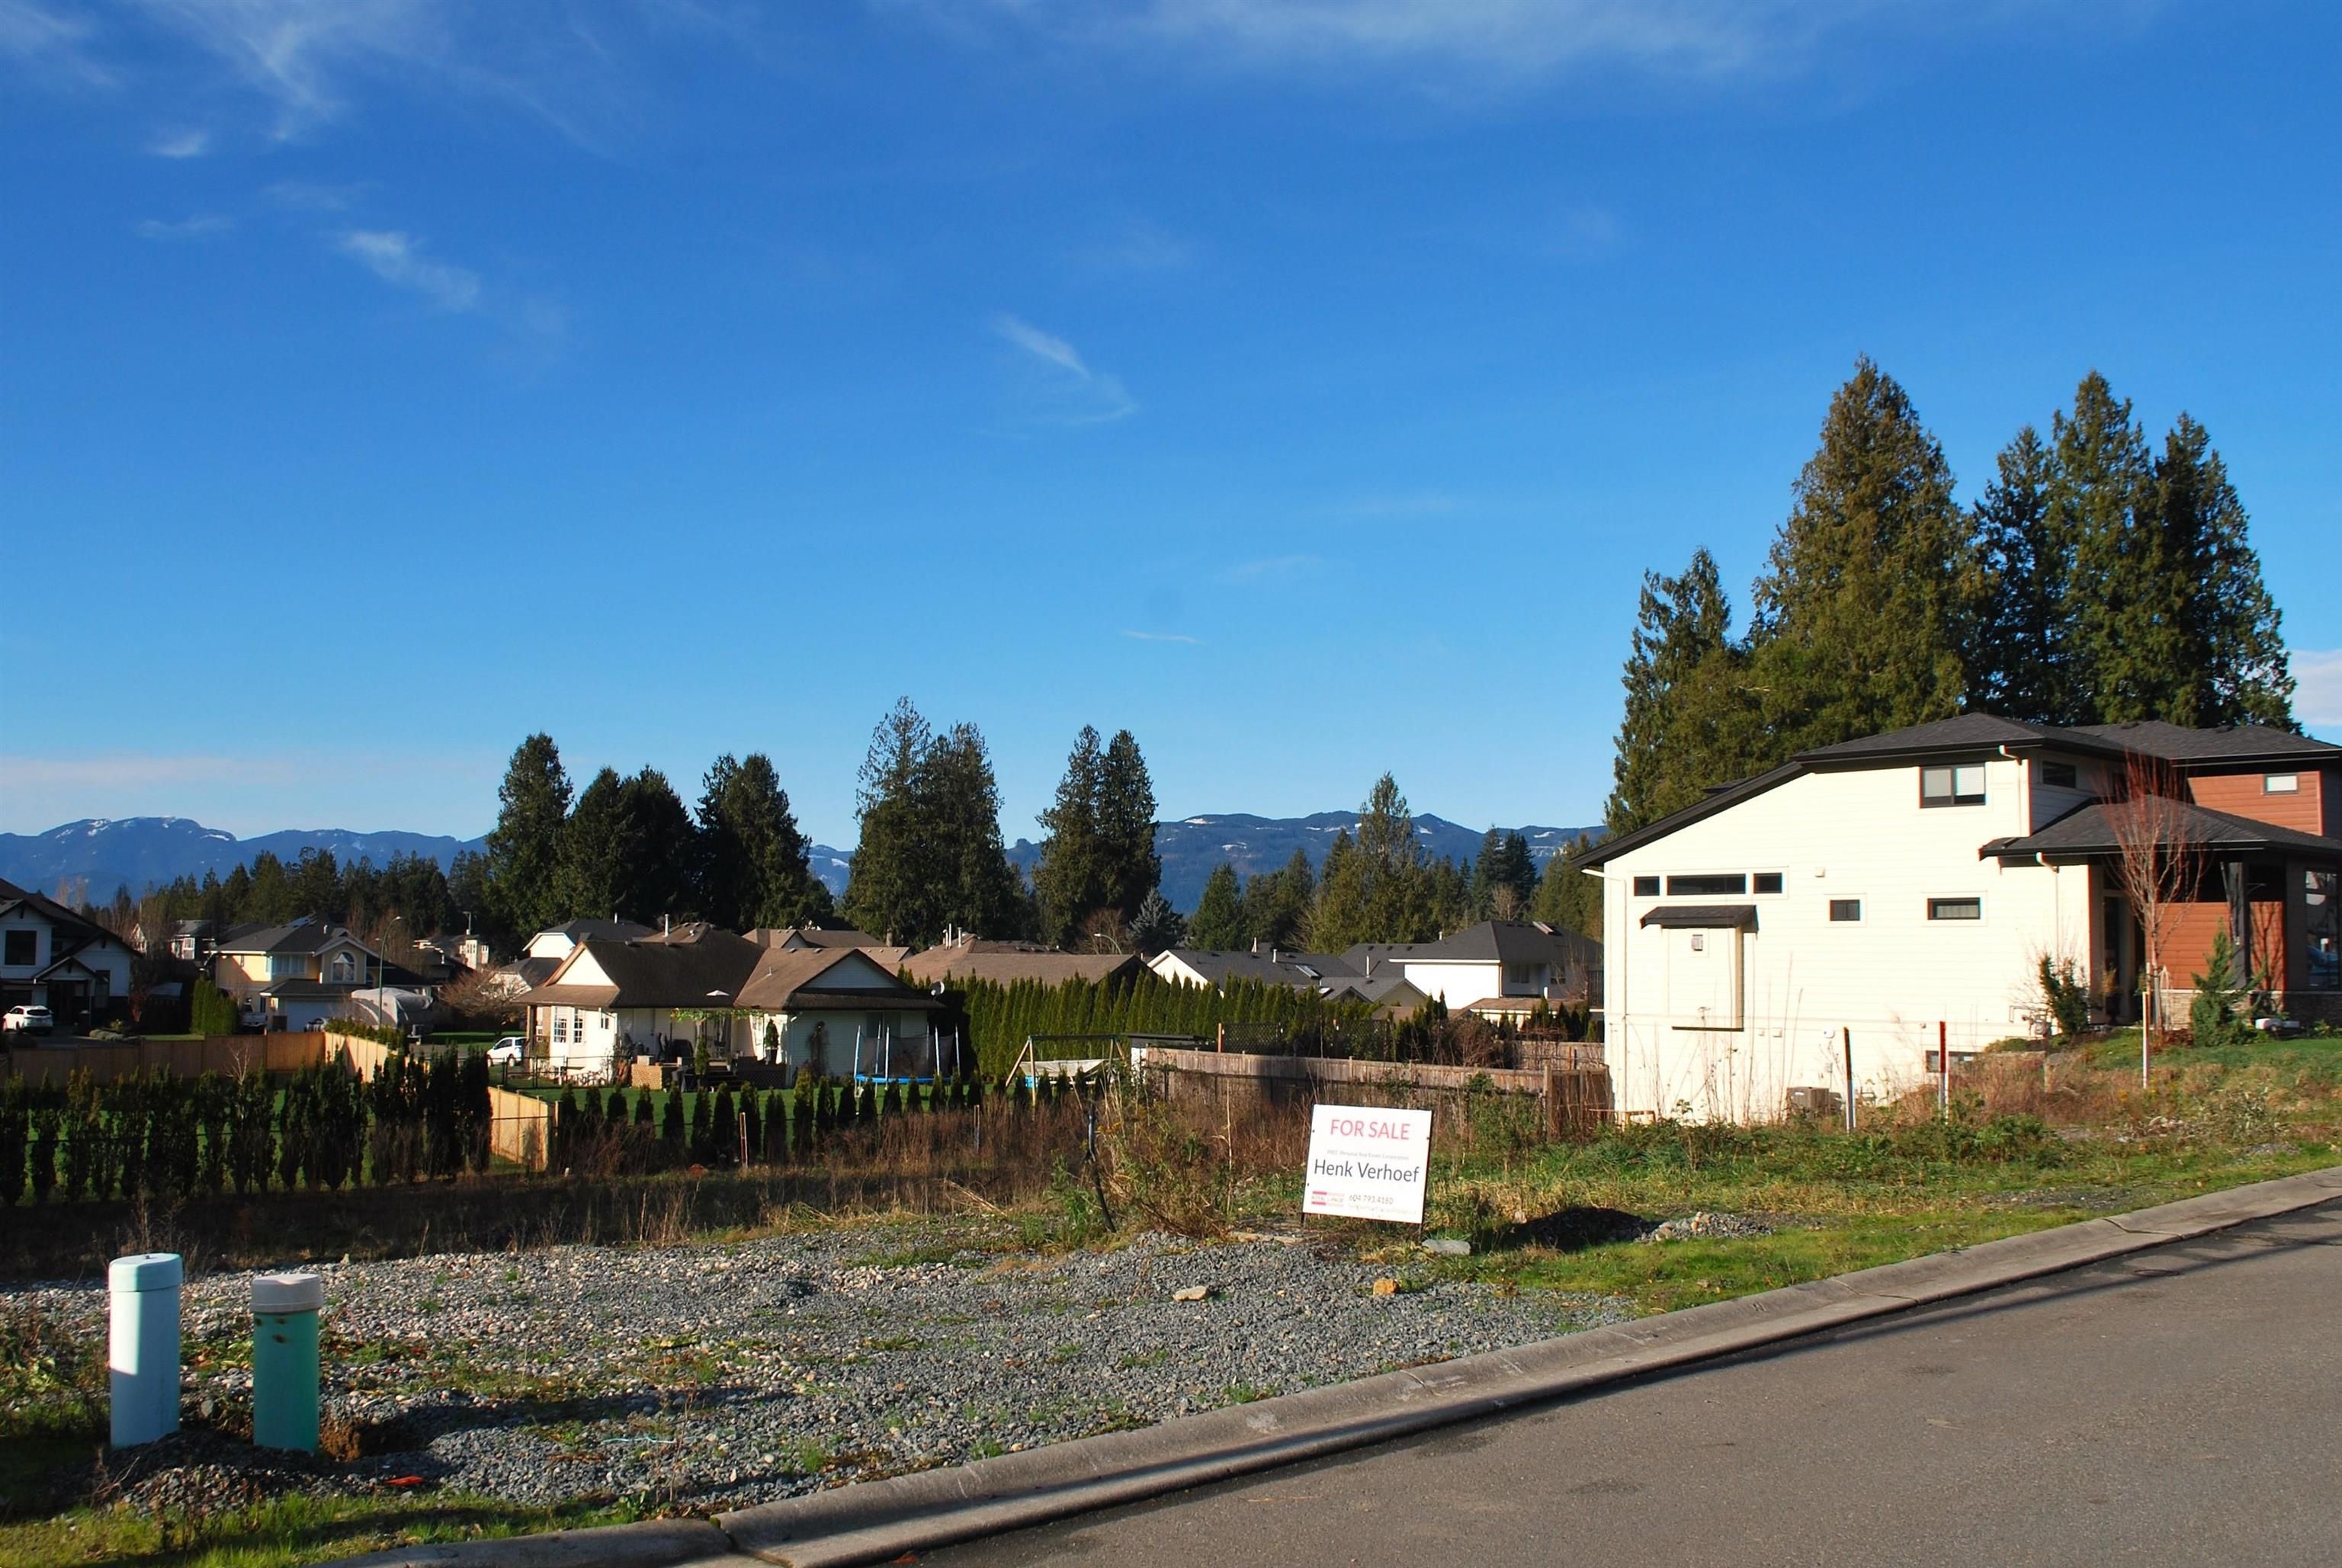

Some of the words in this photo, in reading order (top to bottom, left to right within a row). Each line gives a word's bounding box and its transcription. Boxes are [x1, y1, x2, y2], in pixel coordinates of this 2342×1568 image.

[1330, 1119, 1365, 1137] FOR
[1368, 1121, 1410, 1140] SALE
[1314, 1159, 1353, 1177] Henk
[1358, 1162, 1420, 1182] Verhoef
